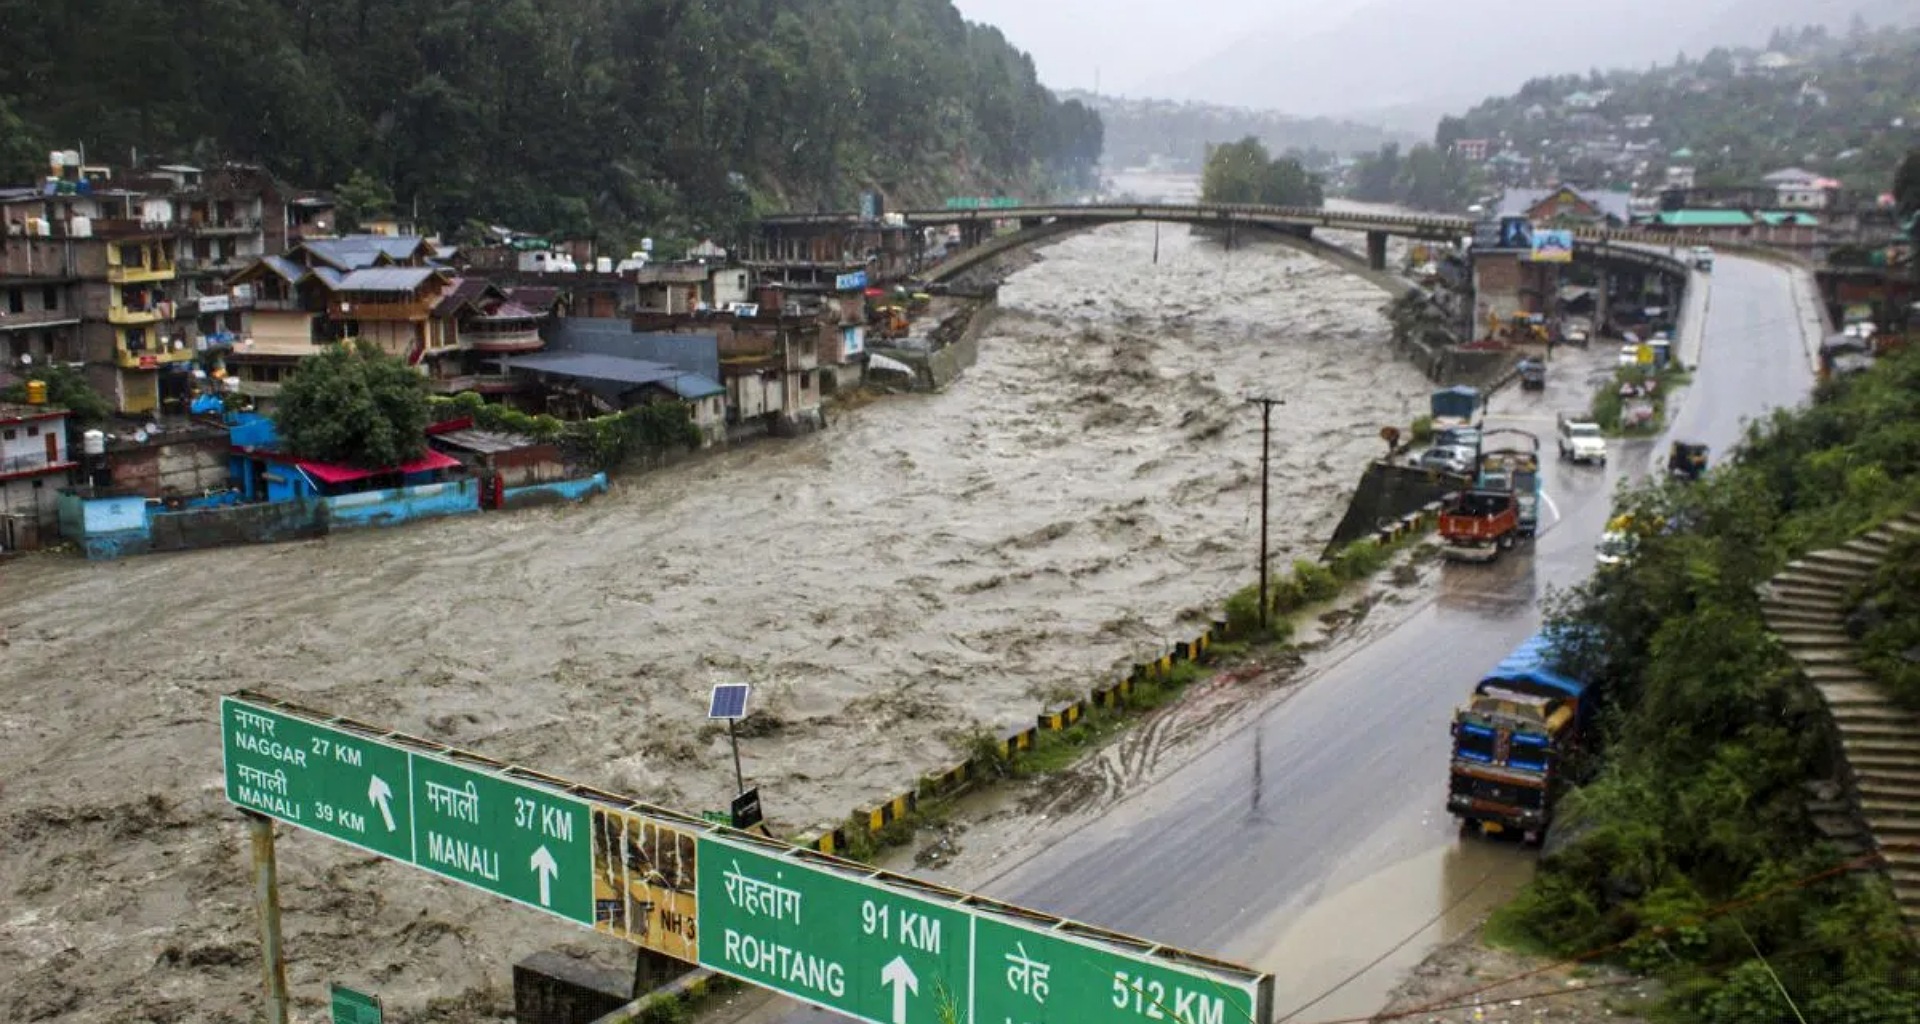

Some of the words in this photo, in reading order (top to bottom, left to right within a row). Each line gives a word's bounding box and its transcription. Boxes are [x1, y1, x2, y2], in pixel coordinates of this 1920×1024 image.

[234, 708, 275, 736] नग्गर
[235, 732, 307, 768] NAGGAR
[312, 737, 330, 756] 27
[335, 745, 362, 767] KM
[237, 763, 288, 797] मनाली
[425, 780, 479, 825] मनाली
[238, 786, 301, 820] MANALI
[315, 801, 334, 823] 39
[338, 809, 365, 833] KM
[514, 797, 536, 830] 37
[542, 804, 573, 843] KM
[427, 830, 499, 881] MANALI
[722, 859, 802, 926] रोहतांग
[661, 909, 683, 936] NH
[686, 917, 697, 940] 3
[861, 900, 889, 939] 91
[900, 909, 941, 955] KM
[724, 928, 845, 998] ROHTANG
[1005, 941, 1050, 1004] लेह
[1112, 971, 1166, 1020] 512
[1173, 987, 1225, 1024] KM
